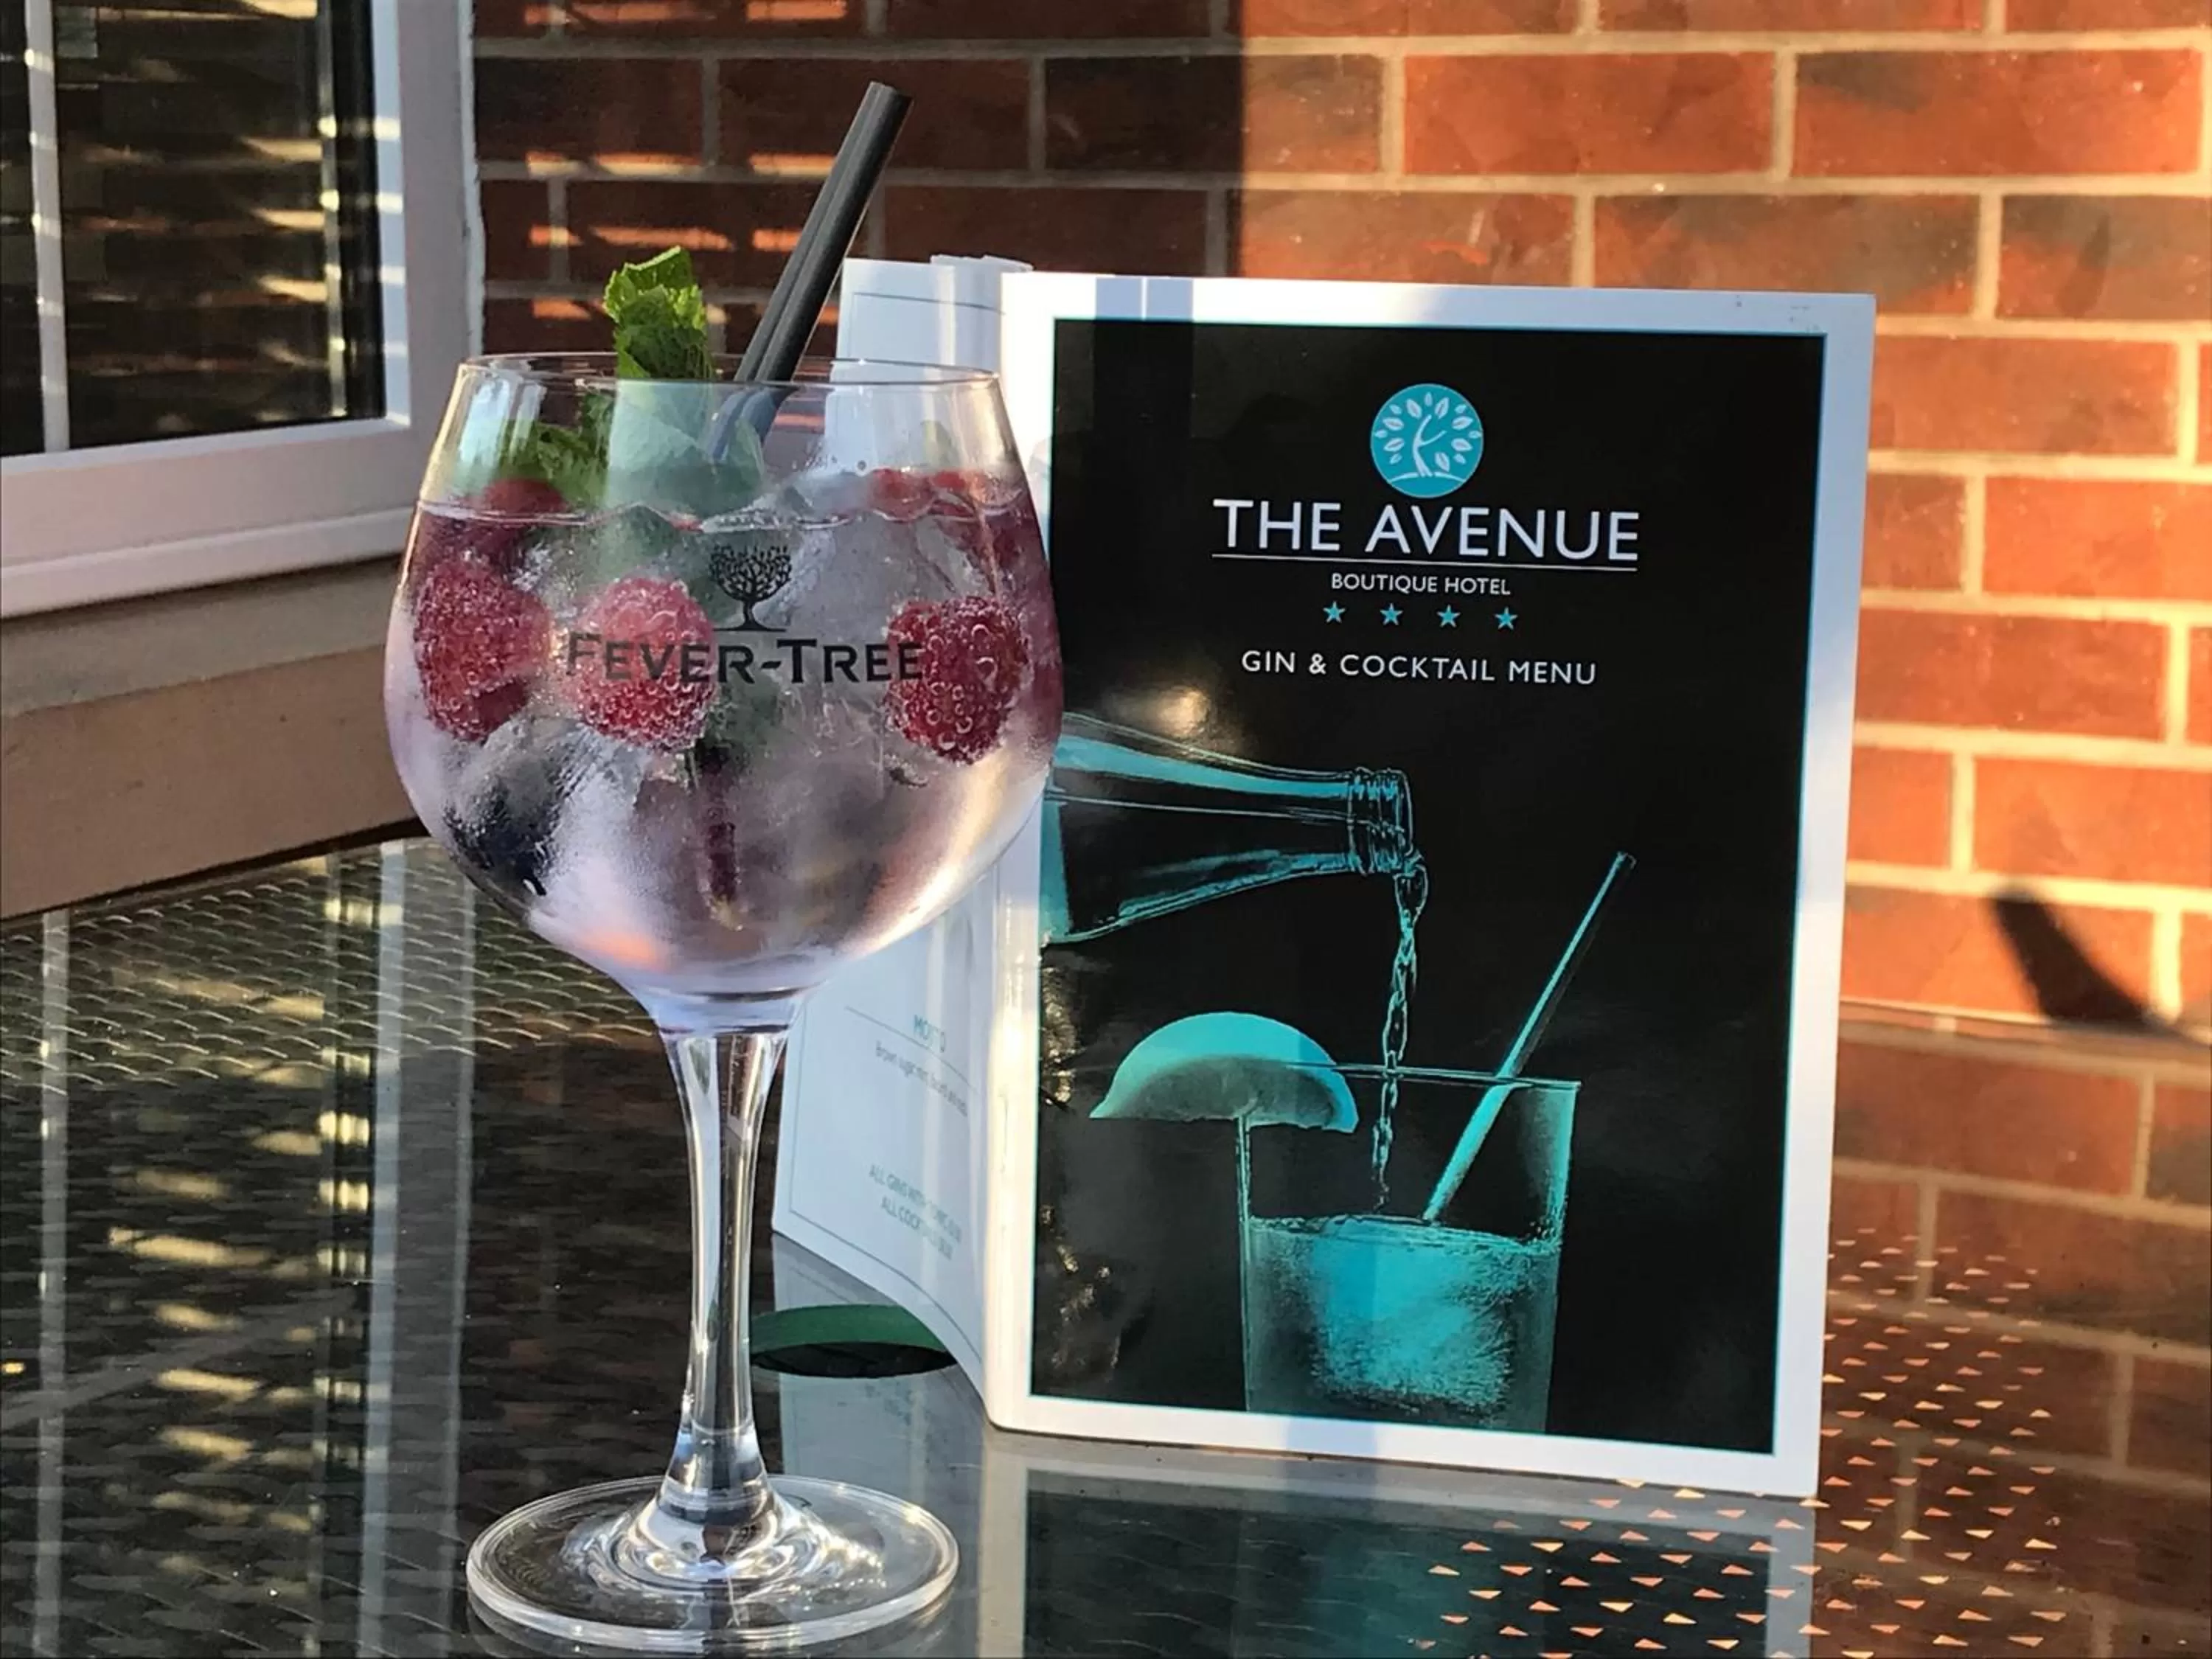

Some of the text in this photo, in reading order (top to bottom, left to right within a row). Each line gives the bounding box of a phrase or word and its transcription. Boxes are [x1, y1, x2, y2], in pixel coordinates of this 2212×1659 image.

[1213, 498, 1639, 560] THE AVENUE
[1332, 573, 1511, 595] BOUTIQUE HOTEL
[567, 631, 924, 684] FEVER-TREE
[1242, 650, 1596, 685] GIN & COCKTAIL MENU
